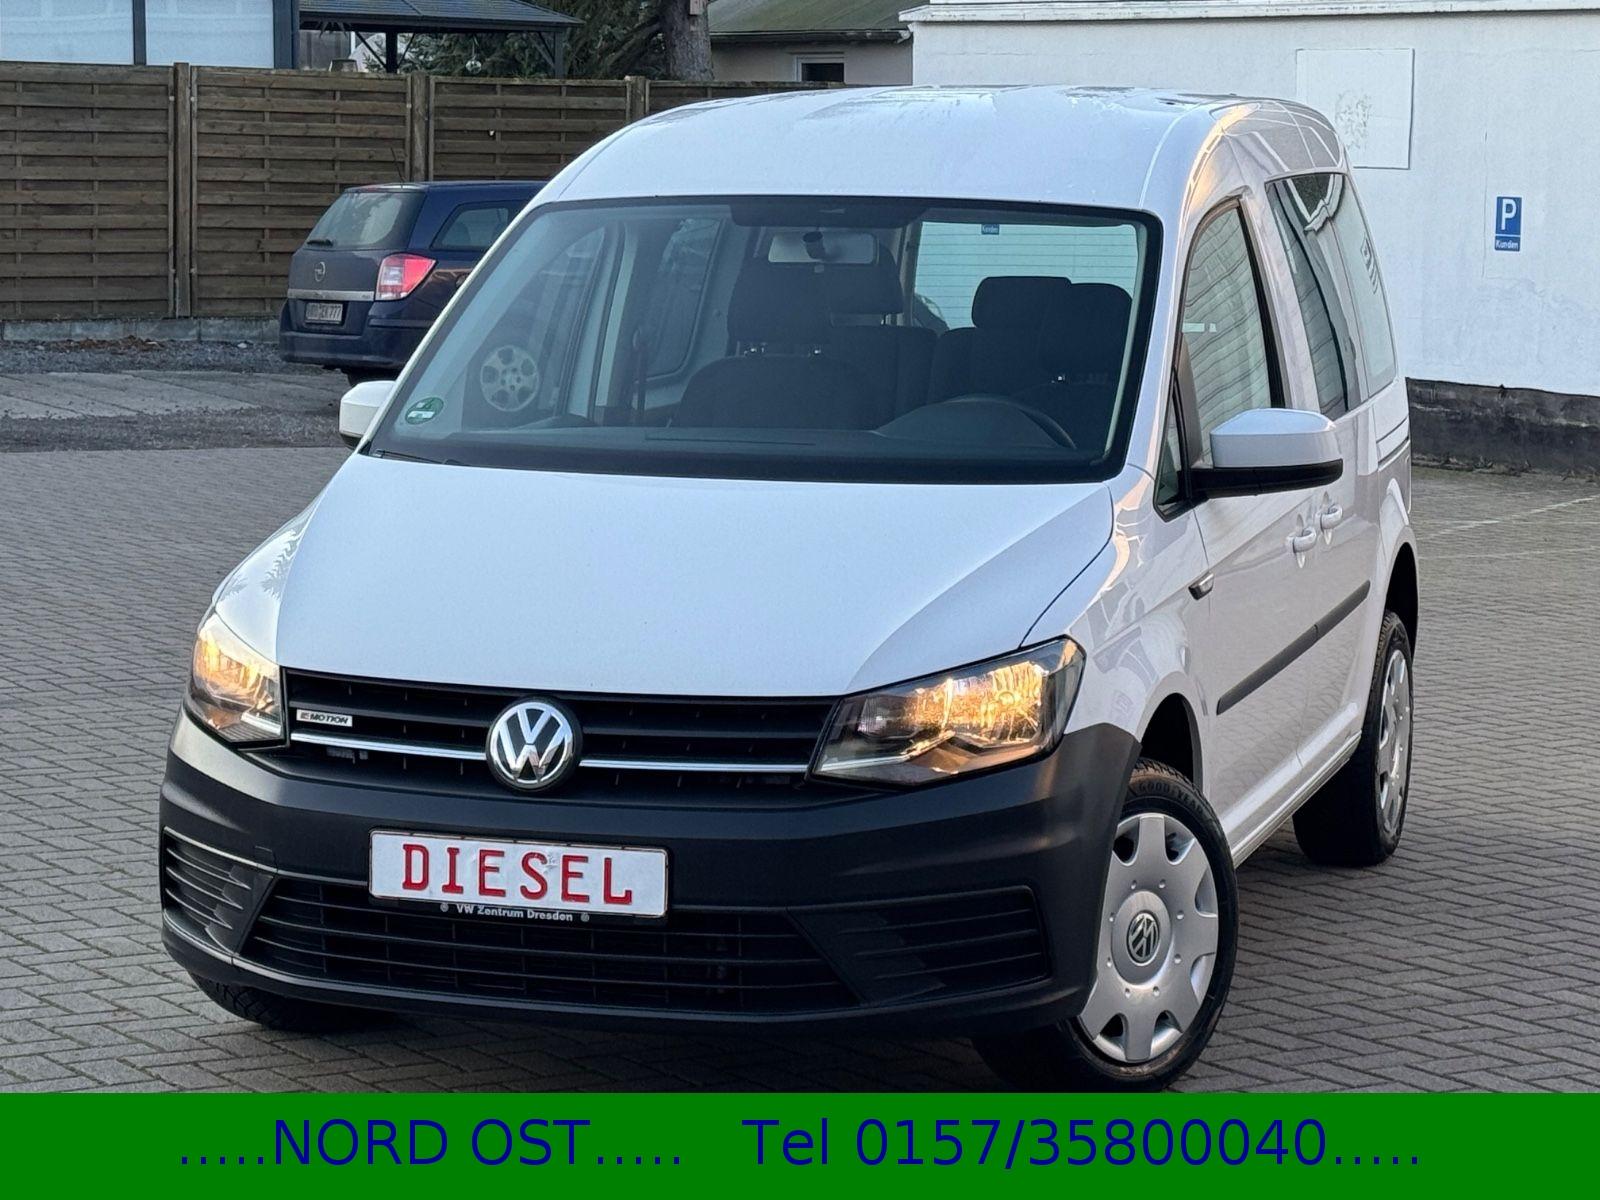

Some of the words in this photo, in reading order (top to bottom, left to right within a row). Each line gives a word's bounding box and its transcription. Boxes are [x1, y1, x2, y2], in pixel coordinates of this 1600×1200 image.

[1501, 198, 1517, 230] P
[1495, 239, 1519, 250] Kunden
[491, 702, 572, 786] VW
[402, 843, 632, 905] DIESEL
[456, 903, 474, 914] VW
[477, 904, 524, 918] Zentrum
[527, 908, 574, 922] Dresden
